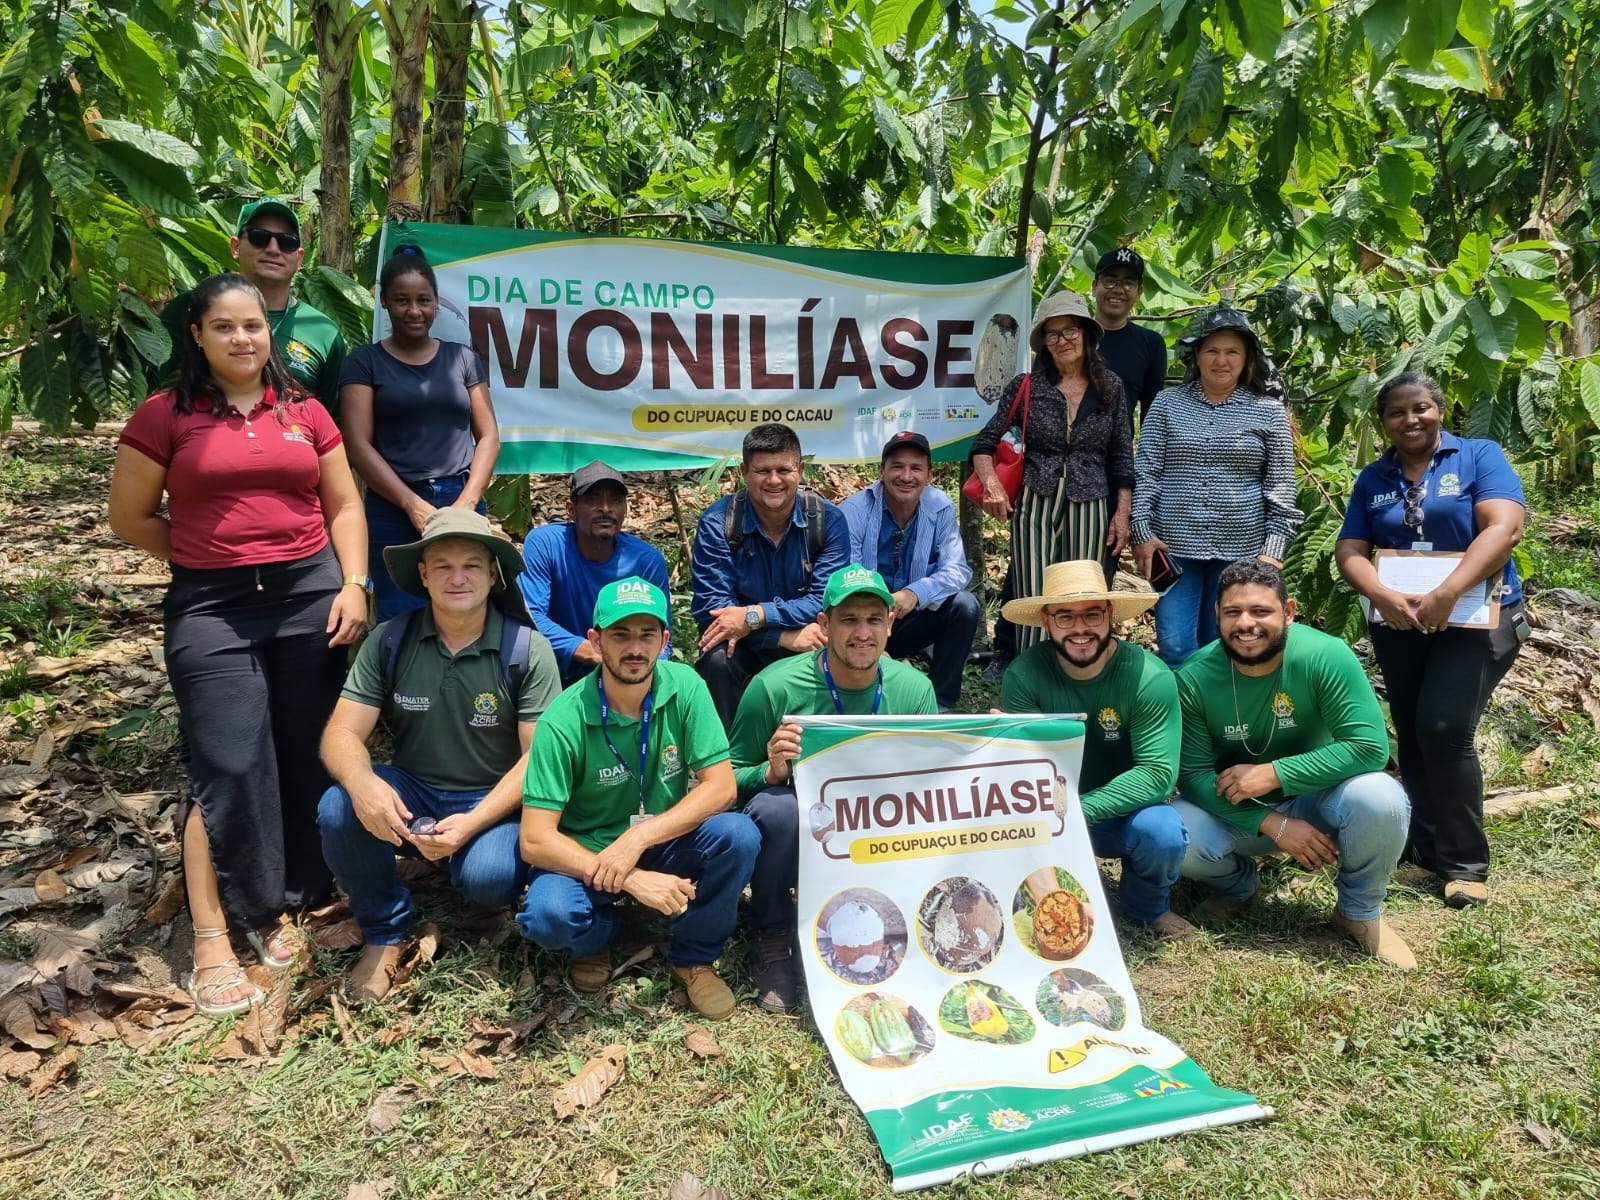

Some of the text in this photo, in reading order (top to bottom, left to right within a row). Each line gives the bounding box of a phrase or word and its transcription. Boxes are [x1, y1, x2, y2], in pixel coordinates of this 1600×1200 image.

[468, 275, 715, 310] DIA DE CAMPO
[468, 298, 976, 391] MONILÍASE
[647, 409, 833, 426] DO CUPUAÇU E DO CACAU
[858, 407, 877, 416] IDAF
[1373, 490, 1398, 504] IDAF
[844, 569, 873, 581] IDAF
[617, 581, 650, 595] IDAF
[1224, 723, 1249, 734] IDAF
[834, 776, 1055, 833] MONILÍASE
[869, 827, 1036, 855] DO CUPUAÇU E DO CACAU
[921, 1112, 974, 1140] IDAF
